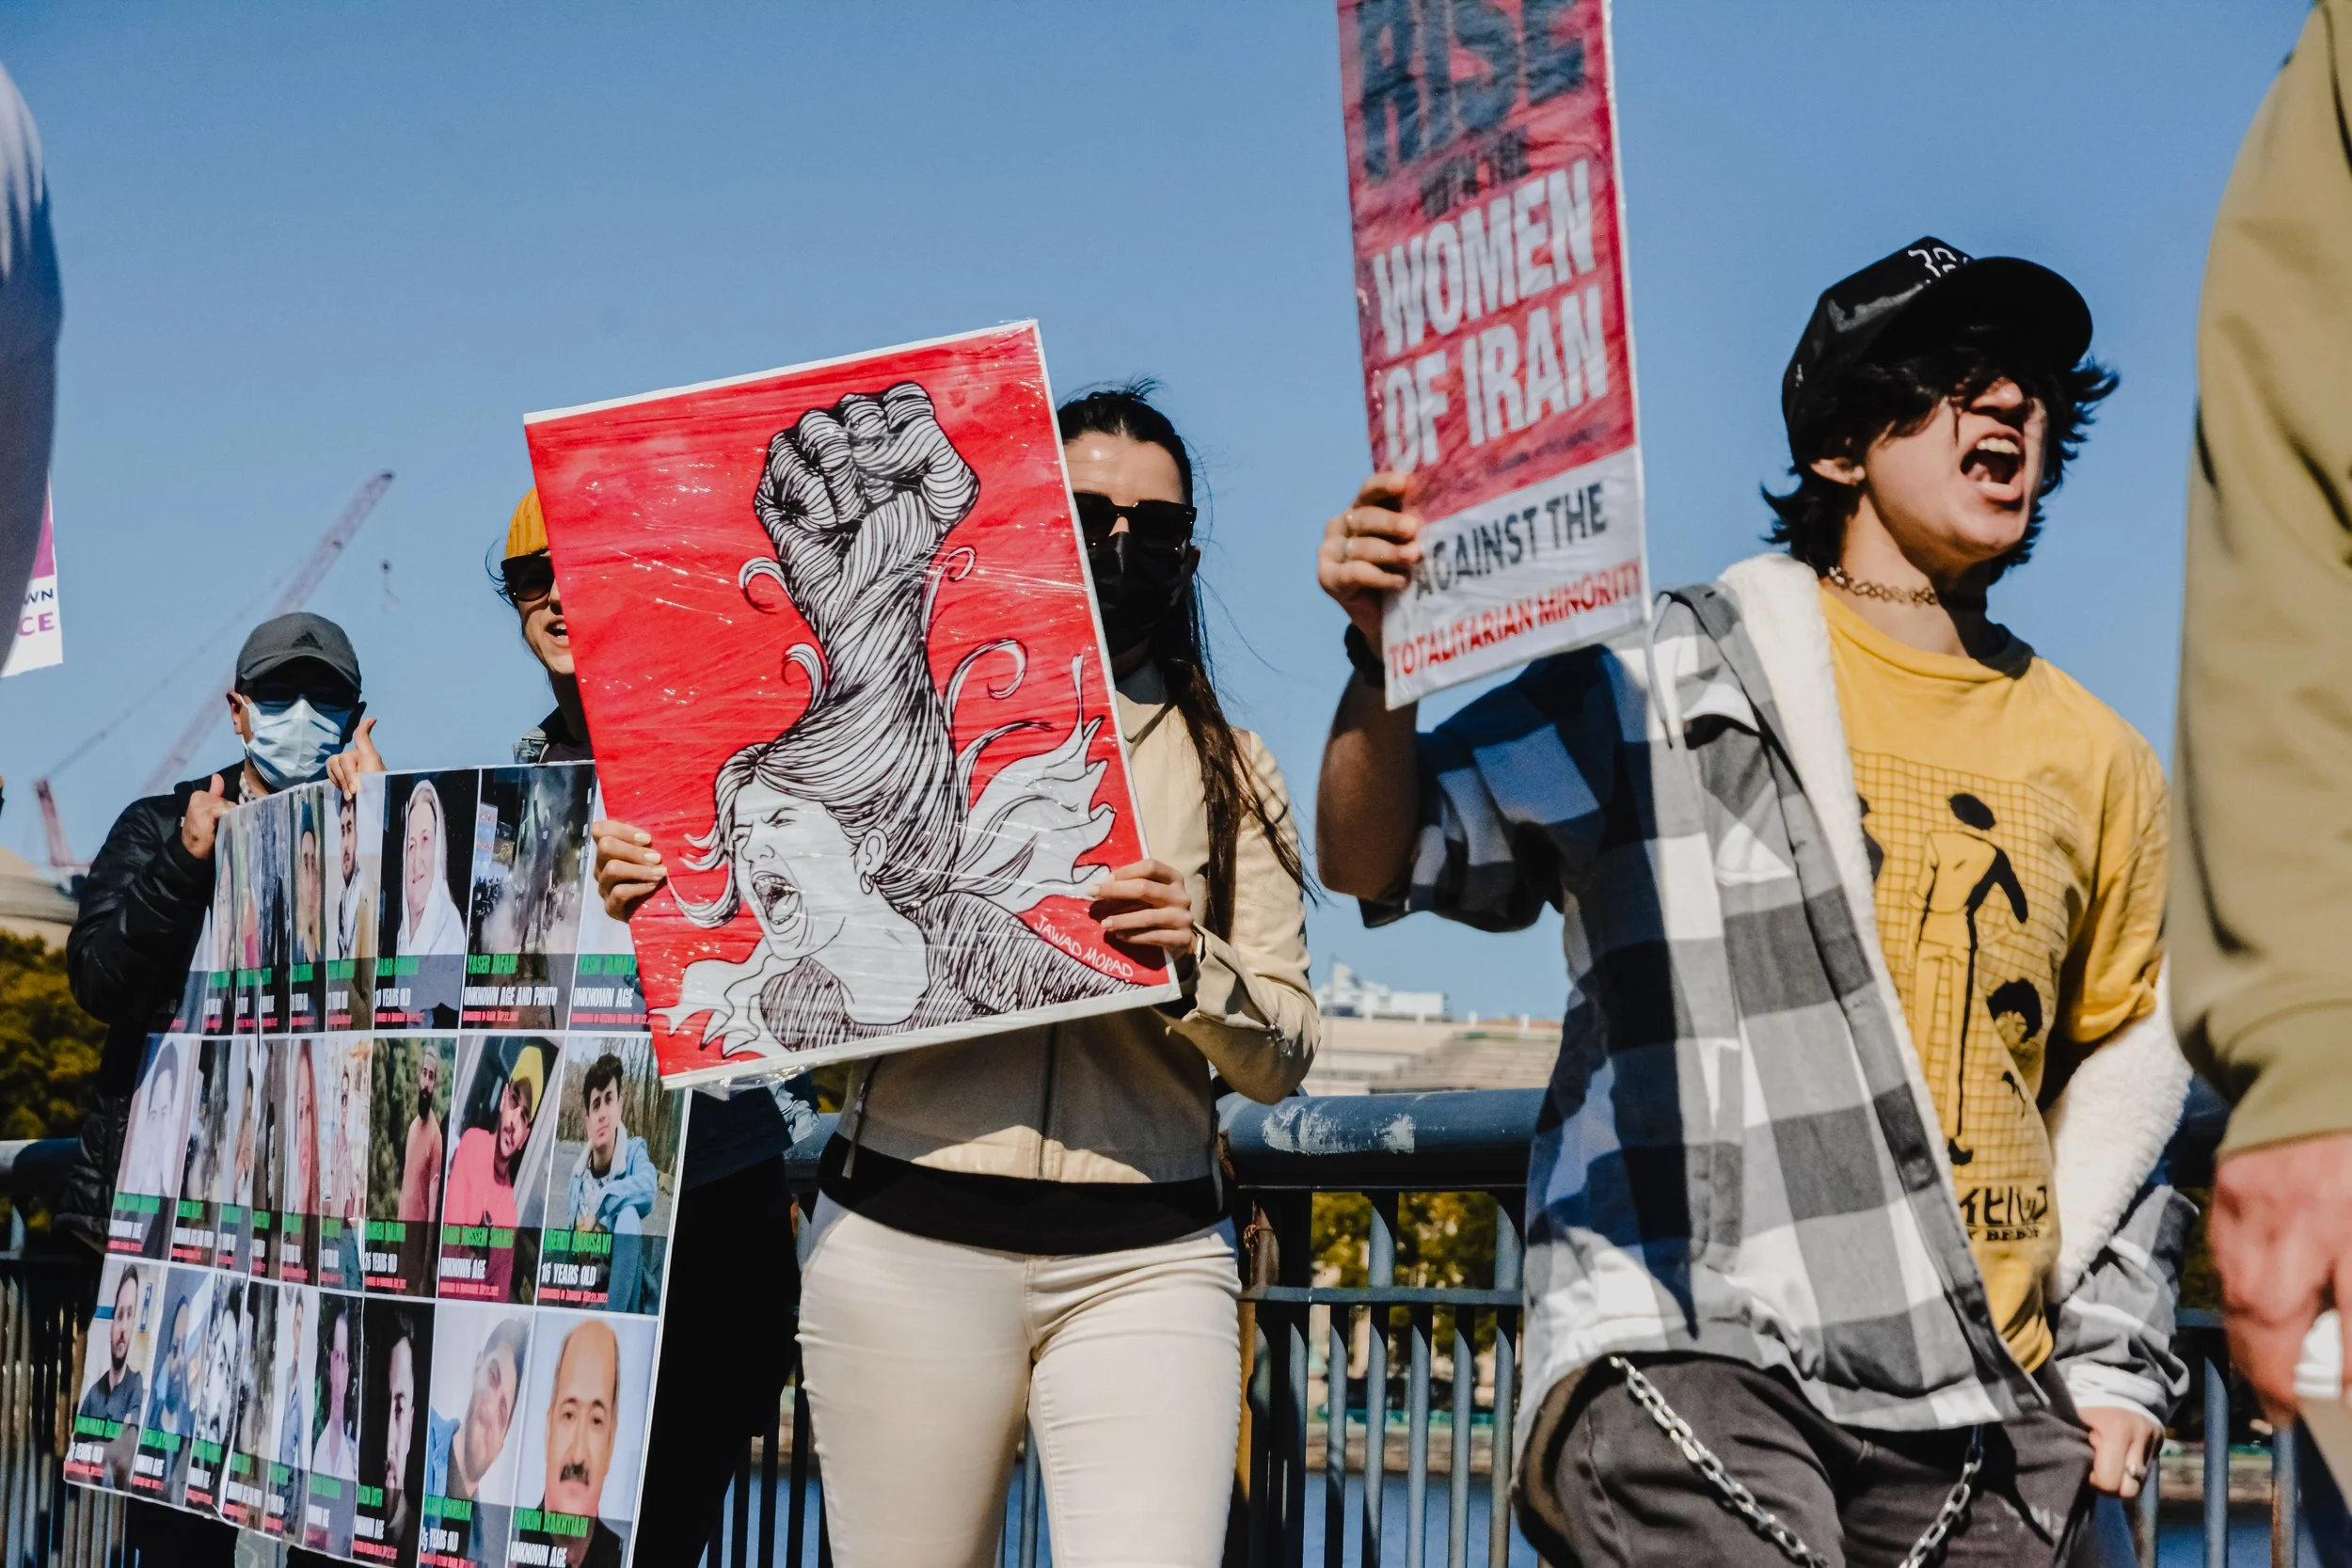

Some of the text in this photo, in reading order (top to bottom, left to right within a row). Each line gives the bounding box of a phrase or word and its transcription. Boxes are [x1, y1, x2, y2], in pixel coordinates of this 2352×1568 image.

[1373, 159, 1597, 356] WOMEN
[1385, 284, 1608, 475] OF IRAN
[1416, 483, 1608, 600] AGAINST THE
[1388, 595, 1534, 678] TOTALITARIAN
[1034, 914, 1082, 957] JAWAD
[464, 987, 558, 1006] UNKNOWN AGE AND PHOTO
[573, 988, 634, 1008] UNKNOWN AGE
[471, 1259, 486, 1279] AGE
[541, 1261, 596, 1286] 16 YEARS OLD
[510, 1542, 568, 1568] UNKNOWN AGE
